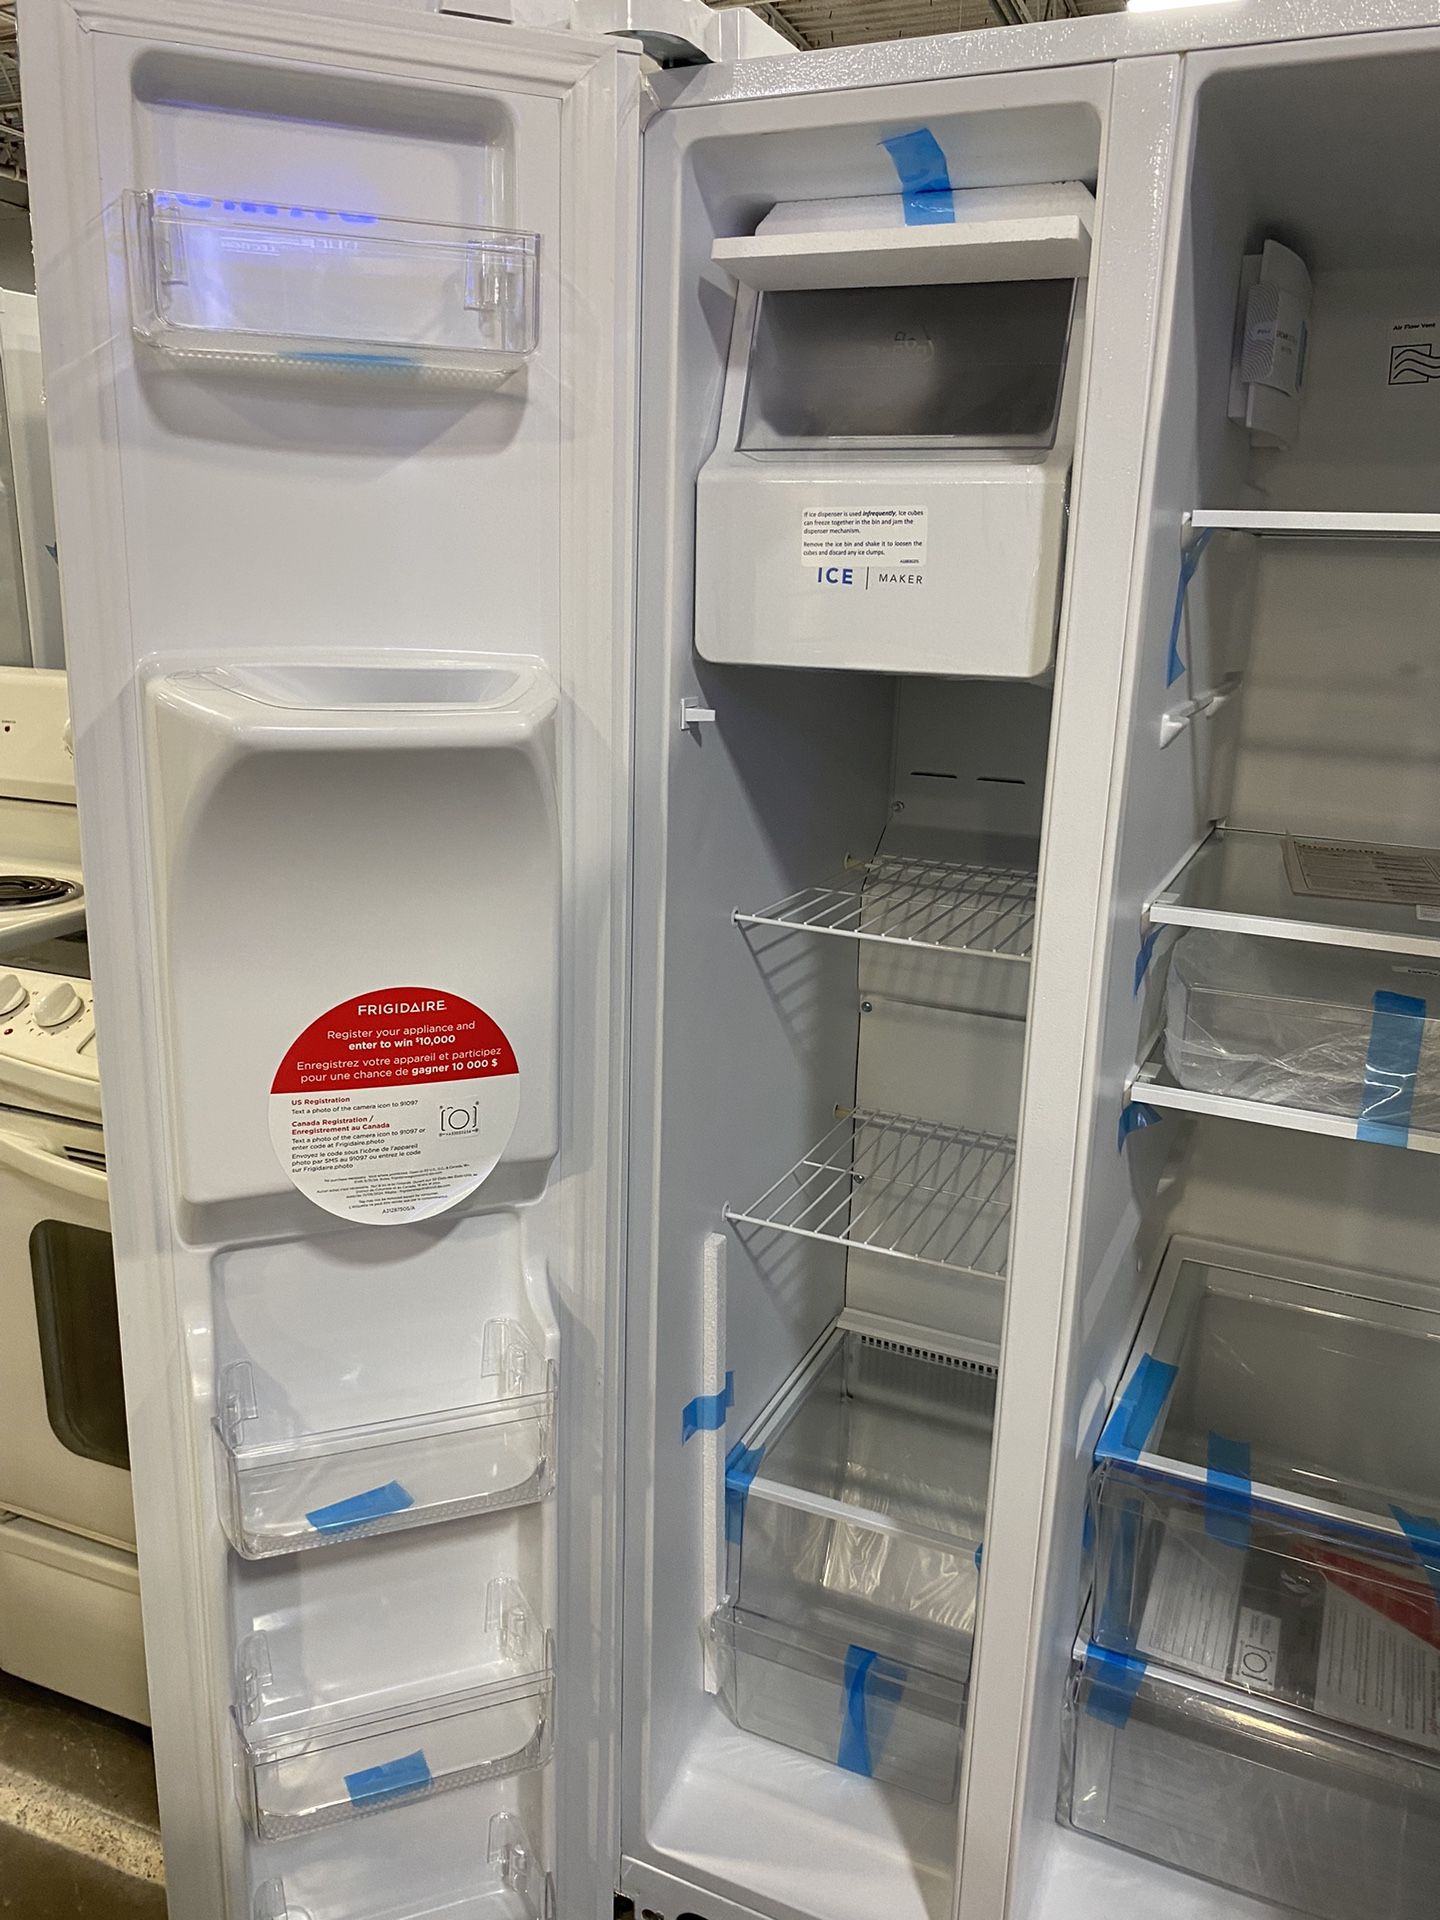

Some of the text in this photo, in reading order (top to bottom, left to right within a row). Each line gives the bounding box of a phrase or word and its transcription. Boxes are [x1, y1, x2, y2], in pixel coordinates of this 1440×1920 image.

[818, 567, 923, 584] ICE MAKER
[358, 1000, 447, 1016] FRIGIDAIRE
[327, 1021, 475, 1041] Register your appliance and
[349, 1035, 456, 1051] enter to win $10,000
[297, 1048, 501, 1071] Enregistrez votre appareil et participez
[301, 1058, 498, 1083] pour une chance de gagner 10 000 $
[304, 1096, 350, 1106] Registration
[322, 1116, 368, 1126] Registration
[292, 1126, 349, 1136] Enregistrement
